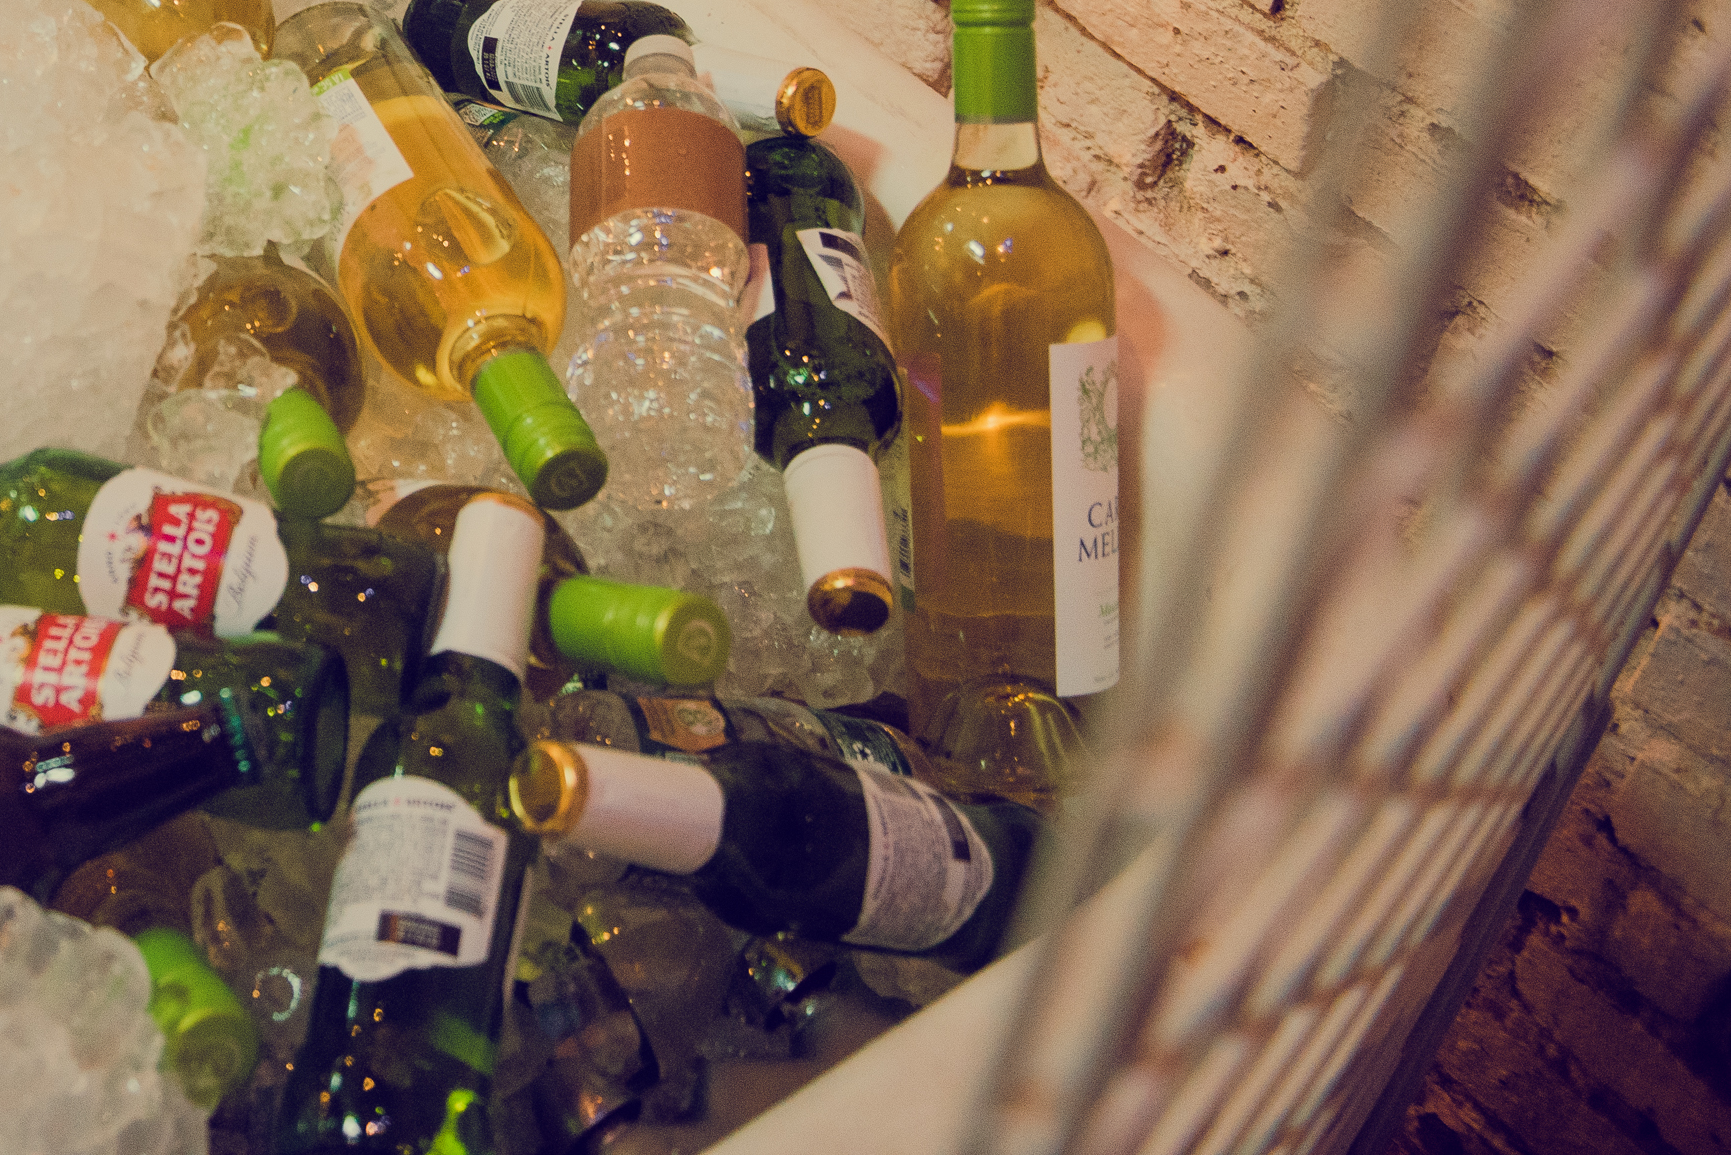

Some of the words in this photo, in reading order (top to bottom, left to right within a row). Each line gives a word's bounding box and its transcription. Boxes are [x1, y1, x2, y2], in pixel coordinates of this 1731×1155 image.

[544, 52, 552, 88] ARTOIS
[141, 497, 196, 613] STELLA
[166, 503, 223, 622] ARTOIS
[225, 534, 260, 610] Belgium
